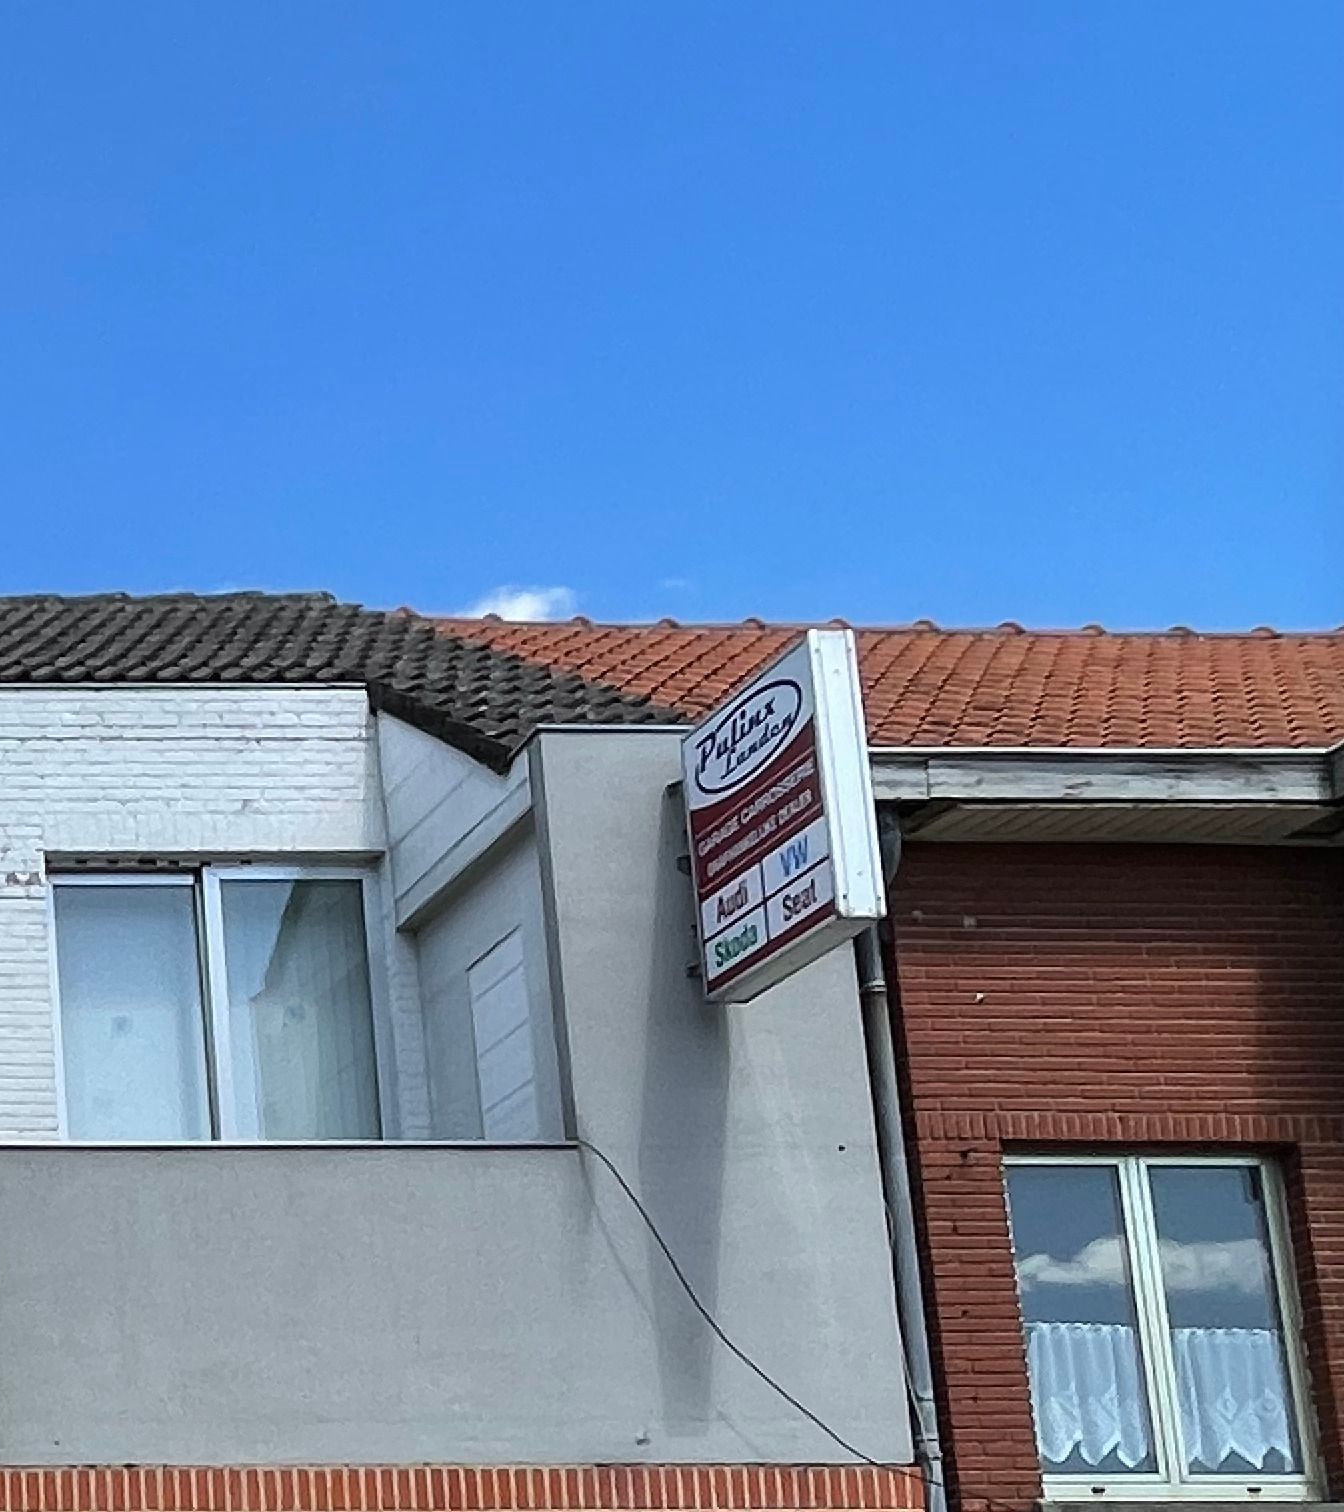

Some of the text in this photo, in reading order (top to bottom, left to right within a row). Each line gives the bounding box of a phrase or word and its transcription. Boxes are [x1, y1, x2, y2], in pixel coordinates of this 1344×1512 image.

[695, 697, 775, 773] Pulinx
[720, 712, 792, 780] Landen
[779, 834, 808, 878] VW
[716, 878, 748, 923] Audi
[782, 878, 817, 922] Seat
[714, 923, 758, 968] Skoda
